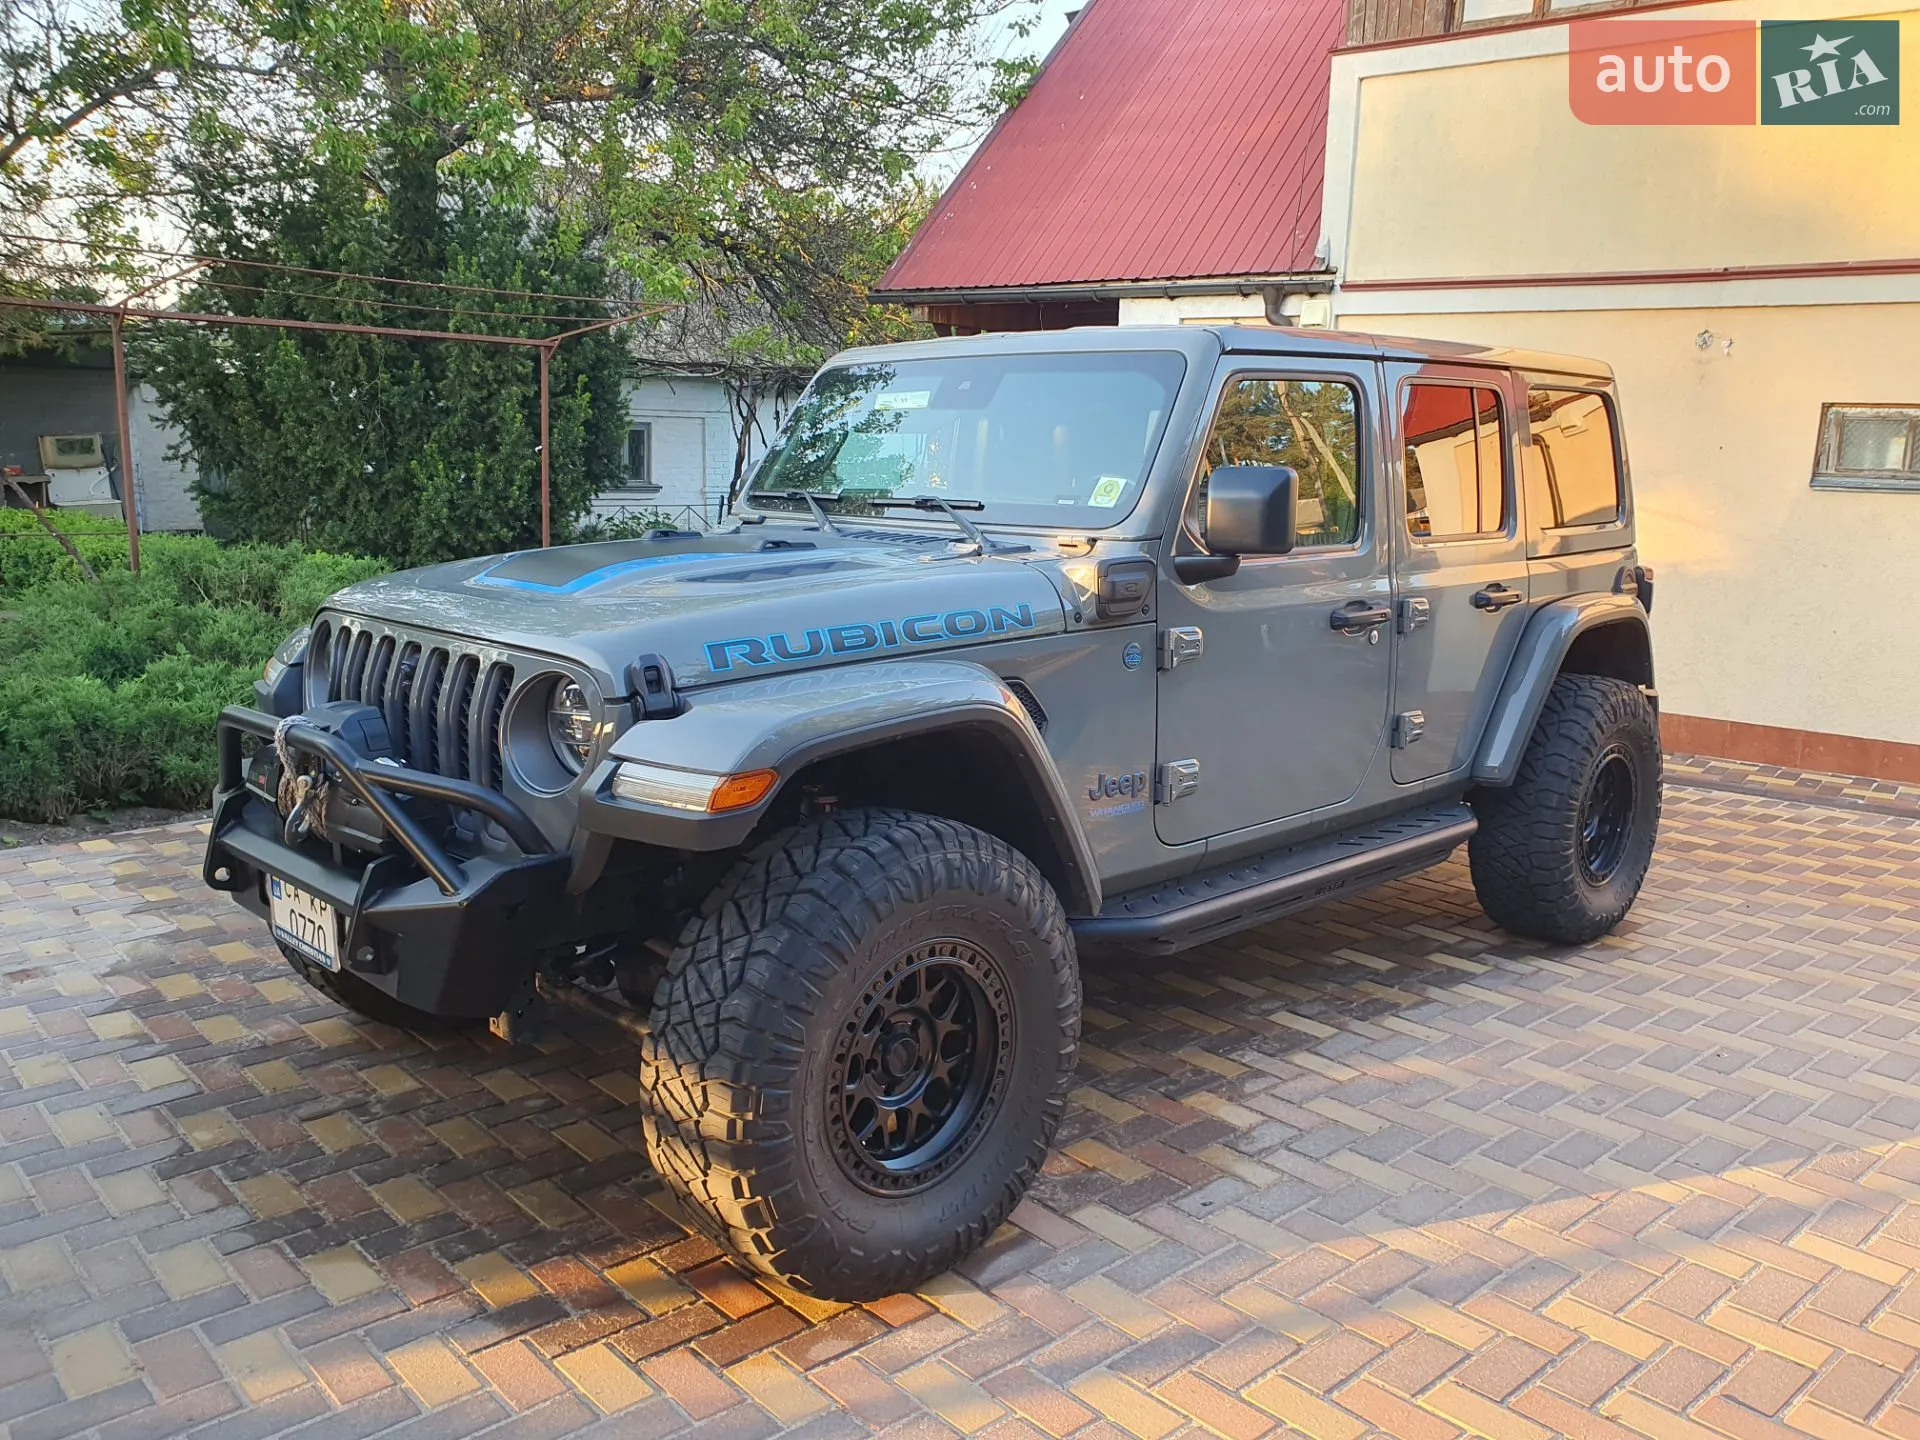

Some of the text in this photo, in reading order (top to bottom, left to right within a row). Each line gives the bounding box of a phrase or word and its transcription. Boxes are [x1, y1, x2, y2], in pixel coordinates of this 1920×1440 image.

[703, 602, 1036, 672] RUBICON
[1089, 772, 1146, 801] Jeep
[289, 908, 327, 952] 0770
